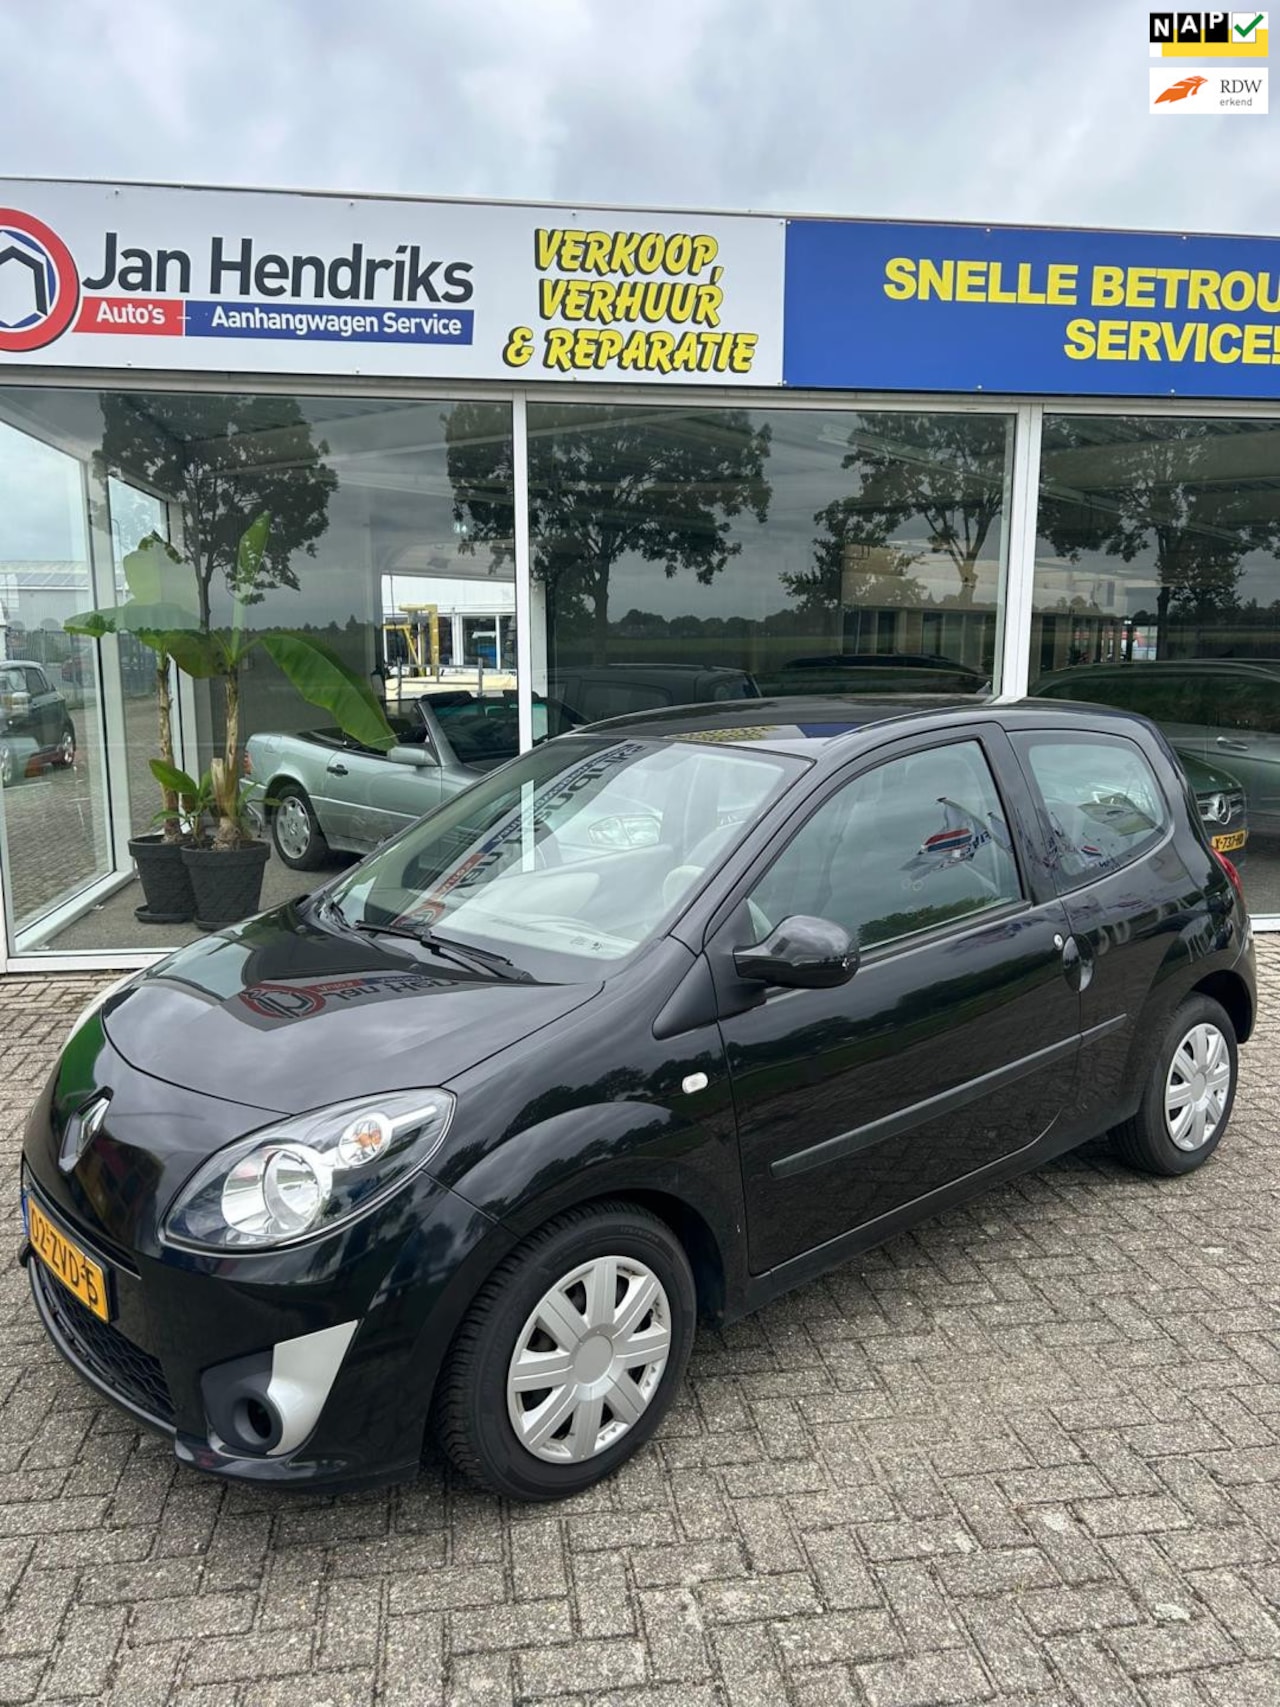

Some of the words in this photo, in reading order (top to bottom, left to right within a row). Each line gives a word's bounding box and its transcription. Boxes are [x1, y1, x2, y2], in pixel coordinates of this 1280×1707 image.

[82, 232, 191, 293] Jan
[534, 228, 724, 286] VERKOOP,
[539, 278, 724, 327] VERHUUR
[884, 257, 1079, 306] SNELLE
[1091, 266, 1280, 314] BETROU
[96, 300, 166, 326] Auto's
[211, 305, 379, 339] Aanhangwagen
[383, 312, 463, 336] Service
[502, 326, 535, 367] &
[543, 328, 759, 375] REPARATIE
[1064, 318, 1280, 365] SERVICE!
